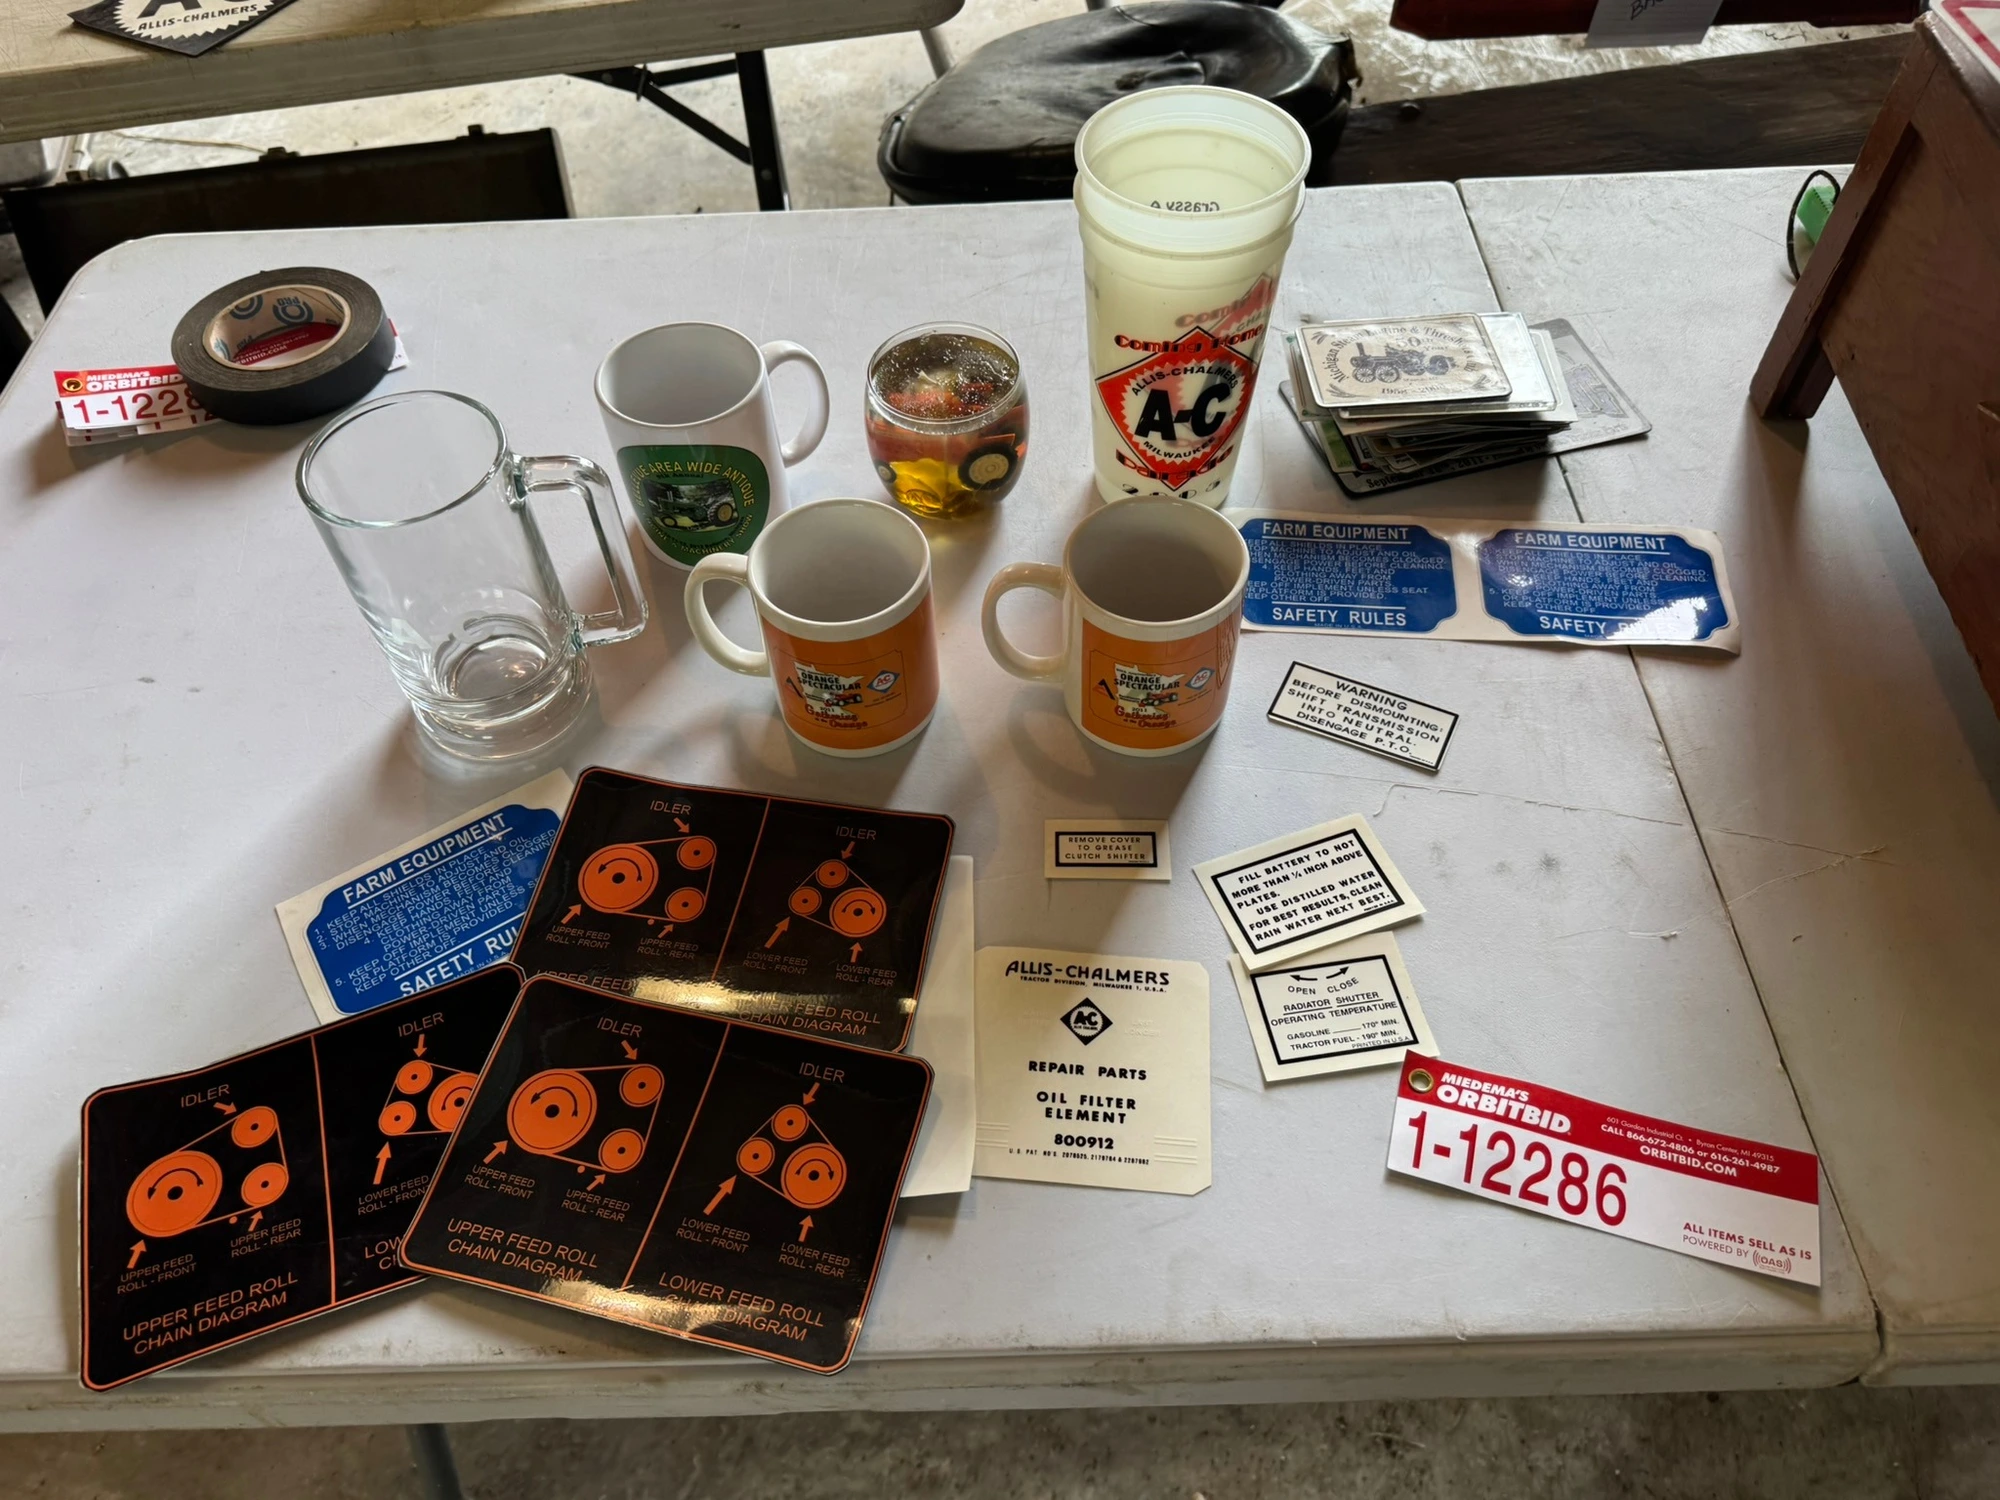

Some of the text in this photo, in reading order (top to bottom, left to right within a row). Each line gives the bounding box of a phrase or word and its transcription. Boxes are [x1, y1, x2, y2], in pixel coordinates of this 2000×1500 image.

[138, 4, 258, 31] ALLIS-CHALMERS
[1114, 324, 1263, 352] Coming Home
[86, 373, 183, 392] ORBITBID
[87, 371, 150, 381] MIEDEMA'S
[1132, 366, 1238, 395] ALLIS-CHALMERS
[1135, 382, 1230, 440] A-C
[1144, 437, 1215, 459] MILWAUKEE
[650, 462, 682, 473] AREA
[687, 462, 722, 475] WIDE
[722, 467, 755, 508] ANTIQUE
[1263, 522, 1408, 540] FARM EQUIPMENT
[1514, 533, 1666, 550] FARM EQUIPMENT
[1272, 608, 1406, 626] SAFETY RULES
[1540, 616, 1606, 634] SAFETY
[797, 677, 861, 691] SPECTACULAR
[801, 672, 839, 684] ORANGE
[1114, 674, 1180, 690] ORANGE SPECTACULAR
[1292, 679, 1443, 732] BEFORE DISMOUNTING:
[1336, 681, 1408, 710] WARNING
[1288, 688, 1440, 743] SHIFT TRANSMISSION
[1301, 702, 1417, 746] INTO NEUTRAL.
[1297, 711, 1412, 755] DISENGAGE P.T.O.
[649, 800, 692, 815] IDLER
[835, 826, 877, 841] IDLER
[342, 813, 507, 903] FARM EQUIPMENT
[1238, 840, 1355, 884] FILL BATTERY TO NOT
[1231, 850, 1363, 899] MORE THAN INCH ABOVE
[327, 873, 431, 929] KEEP SHIELDS
[1237, 891, 1281, 909] PLATES.
[1256, 870, 1375, 915] USE DISTILLED WATER
[1249, 881, 1383, 931] FOR BEST RESULTS, CLEAN
[1255, 893, 1390, 942] RAIN WATER NEXT BEST.
[399, 949, 475, 997] SAFETY
[1005, 960, 1170, 986] ALLIS-CHALMERS
[1093, 982, 1133, 990] MILWAUKEE
[1288, 977, 1359, 995] OPEN CLOSE
[840, 1005, 881, 1024] ROLL
[1271, 1001, 1397, 1026] OPERATING TEMPERATURE
[1283, 992, 1379, 1012] RADIATOR SHUTTER
[398, 1012, 444, 1037] IDLER
[596, 1017, 642, 1038] IDLER
[739, 1010, 867, 1036] CHAIN DIAGRAM
[1287, 1028, 1330, 1040] GASOLINE
[1380, 1018, 1400, 1027] MIN.
[1290, 1039, 1331, 1051] TRACTOR
[1332, 1035, 1355, 1045] FUEL
[1380, 1029, 1400, 1037] MIN.
[799, 1062, 845, 1083] IDLER
[1028, 1060, 1147, 1080] REPAIR PARTS
[180, 1084, 230, 1109] IDLER
[1441, 1072, 1529, 1101] MIEDEMA'S
[1036, 1091, 1136, 1110] OIL FILTER
[1436, 1084, 1571, 1134] ORBITBID
[1045, 1107, 1126, 1124] ELEMENT
[1054, 1134, 1114, 1150] 800912
[1601, 1124, 1624, 1137] CALL
[1626, 1131, 1695, 1154] 866-672-4806
[1710, 1152, 1780, 1174] 616-261-4987
[1607, 1116, 1619, 1125] 601
[1621, 1120, 1646, 1132] Gordon
[1696, 1138, 1715, 1150] Byron
[1741, 1149, 1750, 1157] MI
[1752, 1152, 1774, 1162] 49315
[1408, 1111, 1627, 1226] 1-12286
[1640, 1146, 1737, 1177] ORBITBID.COM
[472, 1164, 536, 1188] UPPER FEED
[446, 1218, 598, 1269] UPPER FEED ROLL
[1683, 1222, 1812, 1260] ALL ITEMS SELL AS IS
[1683, 1235, 1748, 1258] POWERED BY
[447, 1240, 582, 1283] CHAIN DIAGRAM
[122, 1271, 298, 1341] UPPER FEED ROLL
[658, 1271, 824, 1327] LOWER FEED ROLL
[134, 1291, 287, 1355] CHAIN DIAGRAM
[723, 1307, 808, 1341] DIAGRAM
